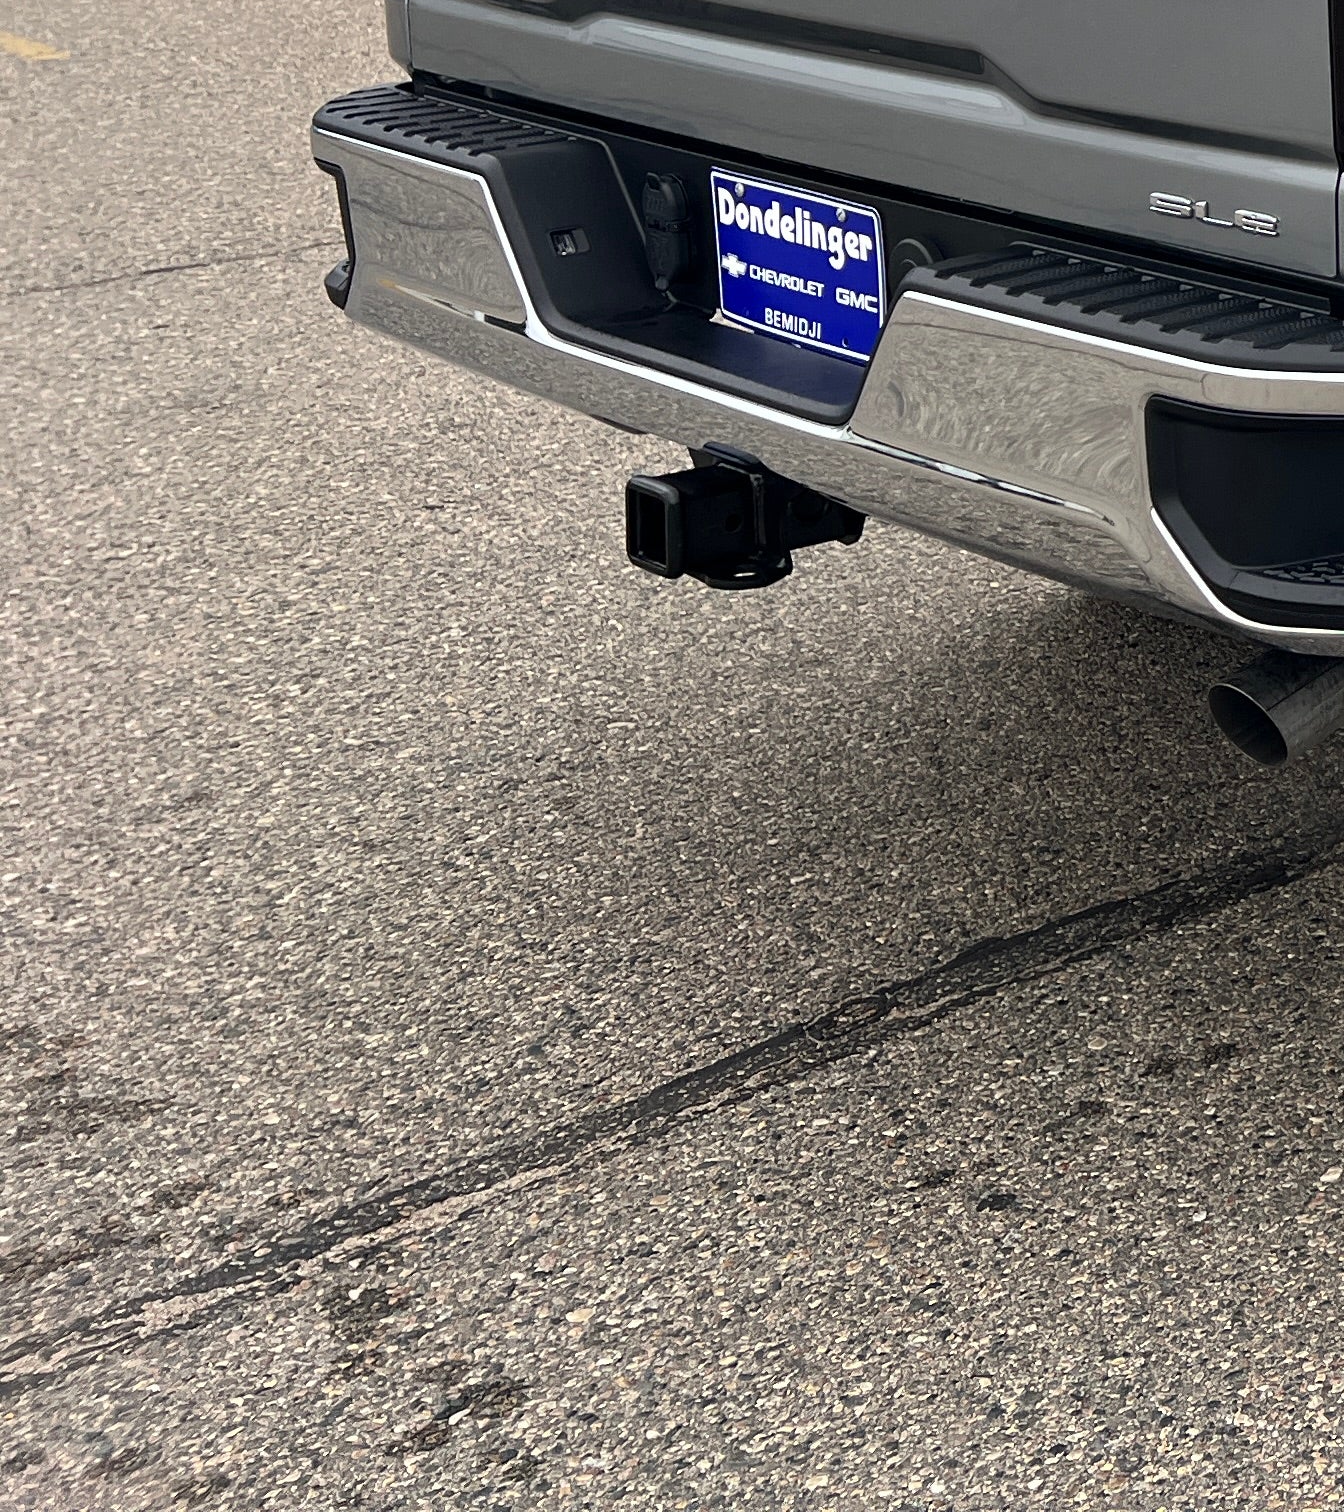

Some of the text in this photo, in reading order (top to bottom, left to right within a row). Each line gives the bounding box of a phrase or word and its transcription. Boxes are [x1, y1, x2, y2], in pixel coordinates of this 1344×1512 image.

[717, 186, 873, 270] Dondelinger
[1149, 191, 1280, 237] SLE
[749, 264, 878, 313] CHEVROLET GMC
[764, 307, 821, 340] BEMIDJI
